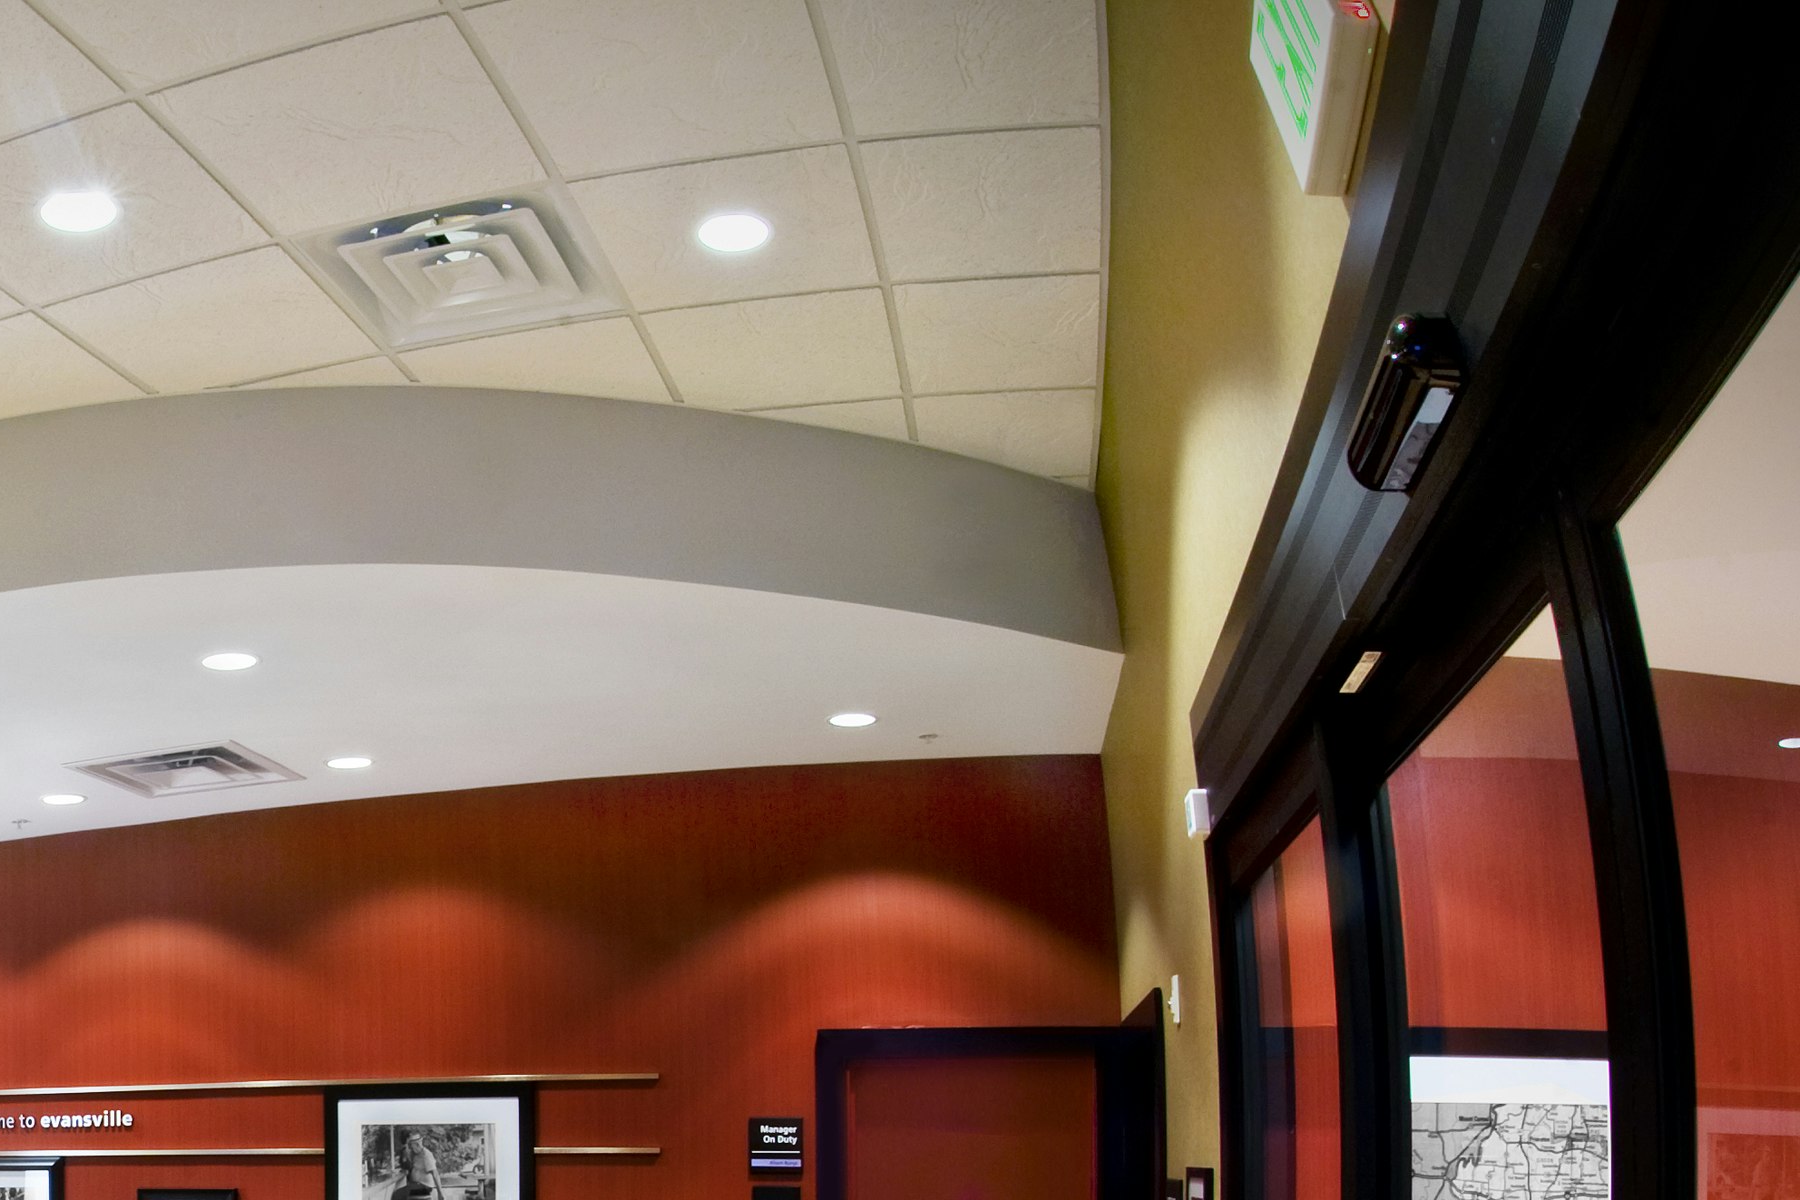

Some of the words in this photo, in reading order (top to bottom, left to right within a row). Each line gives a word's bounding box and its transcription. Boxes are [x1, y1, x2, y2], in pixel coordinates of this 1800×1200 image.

[19, 1114, 36, 1129] to
[40, 1110, 133, 1128] evansville
[760, 1125, 797, 1136] Manager
[763, 1135, 776, 1144] On
[777, 1135, 798, 1146] Duty
